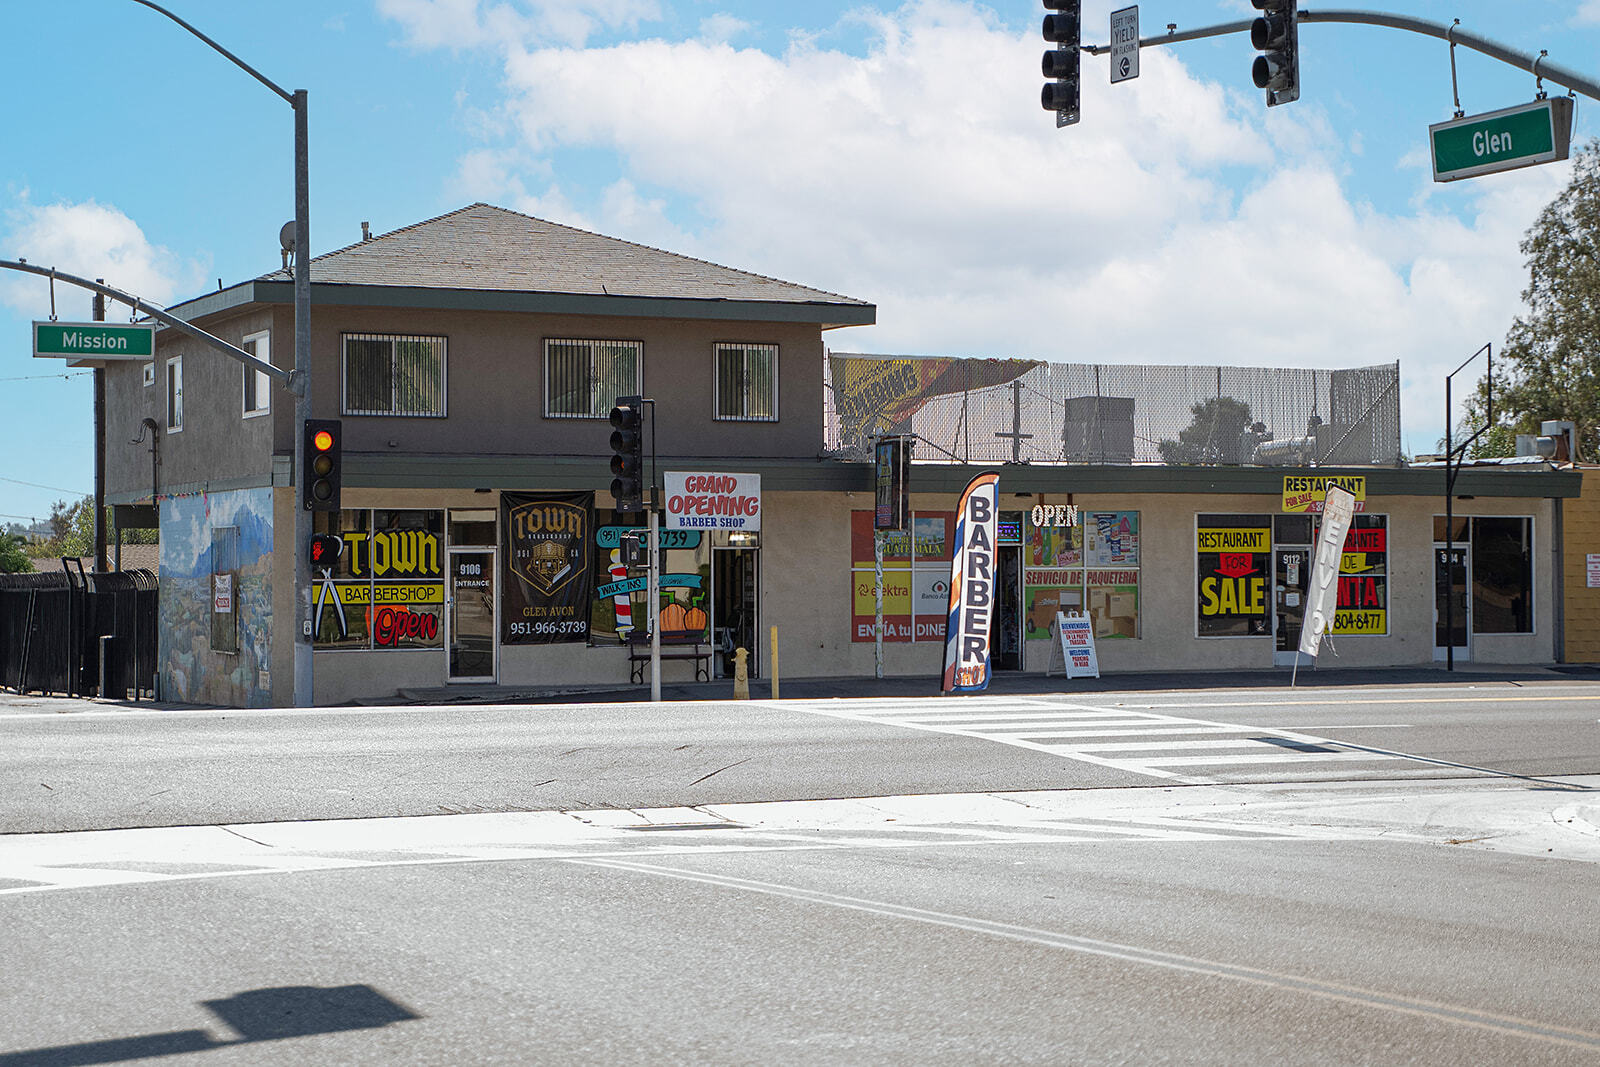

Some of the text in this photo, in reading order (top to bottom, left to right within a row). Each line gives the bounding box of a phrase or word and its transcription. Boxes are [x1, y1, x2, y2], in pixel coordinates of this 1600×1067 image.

[1114, 26, 1135, 44] YIELD
[1472, 130, 1512, 156] Glen
[62, 332, 127, 349] Mission
[684, 475, 737, 494] GRAND
[668, 495, 759, 517] OPENING
[1285, 496, 1298, 507] FOR
[1298, 493, 1312, 504] SALE
[679, 517, 745, 528] BARBER SHOP
[1031, 504, 1079, 527] OPEN
[1199, 532, 1263, 548] RESTAURANT
[1225, 555, 1248, 569] FOR
[1283, 554, 1300, 564] 9112
[1344, 555, 1357, 569] DE
[460, 563, 481, 576] 9106
[963, 496, 991, 663] BARBER
[1026, 571, 1138, 585] SERVICIO DE PAQUETERIA
[346, 588, 435, 601] BARBERSHOP
[871, 584, 908, 597] eektra
[1202, 577, 1264, 615] SALE
[1338, 577, 1378, 606] NTA
[522, 606, 574, 617] GLEN AVON
[375, 608, 438, 647] Open
[510, 621, 586, 635] 951-966-3739
[858, 620, 946, 637] ENÍA tu DINE
